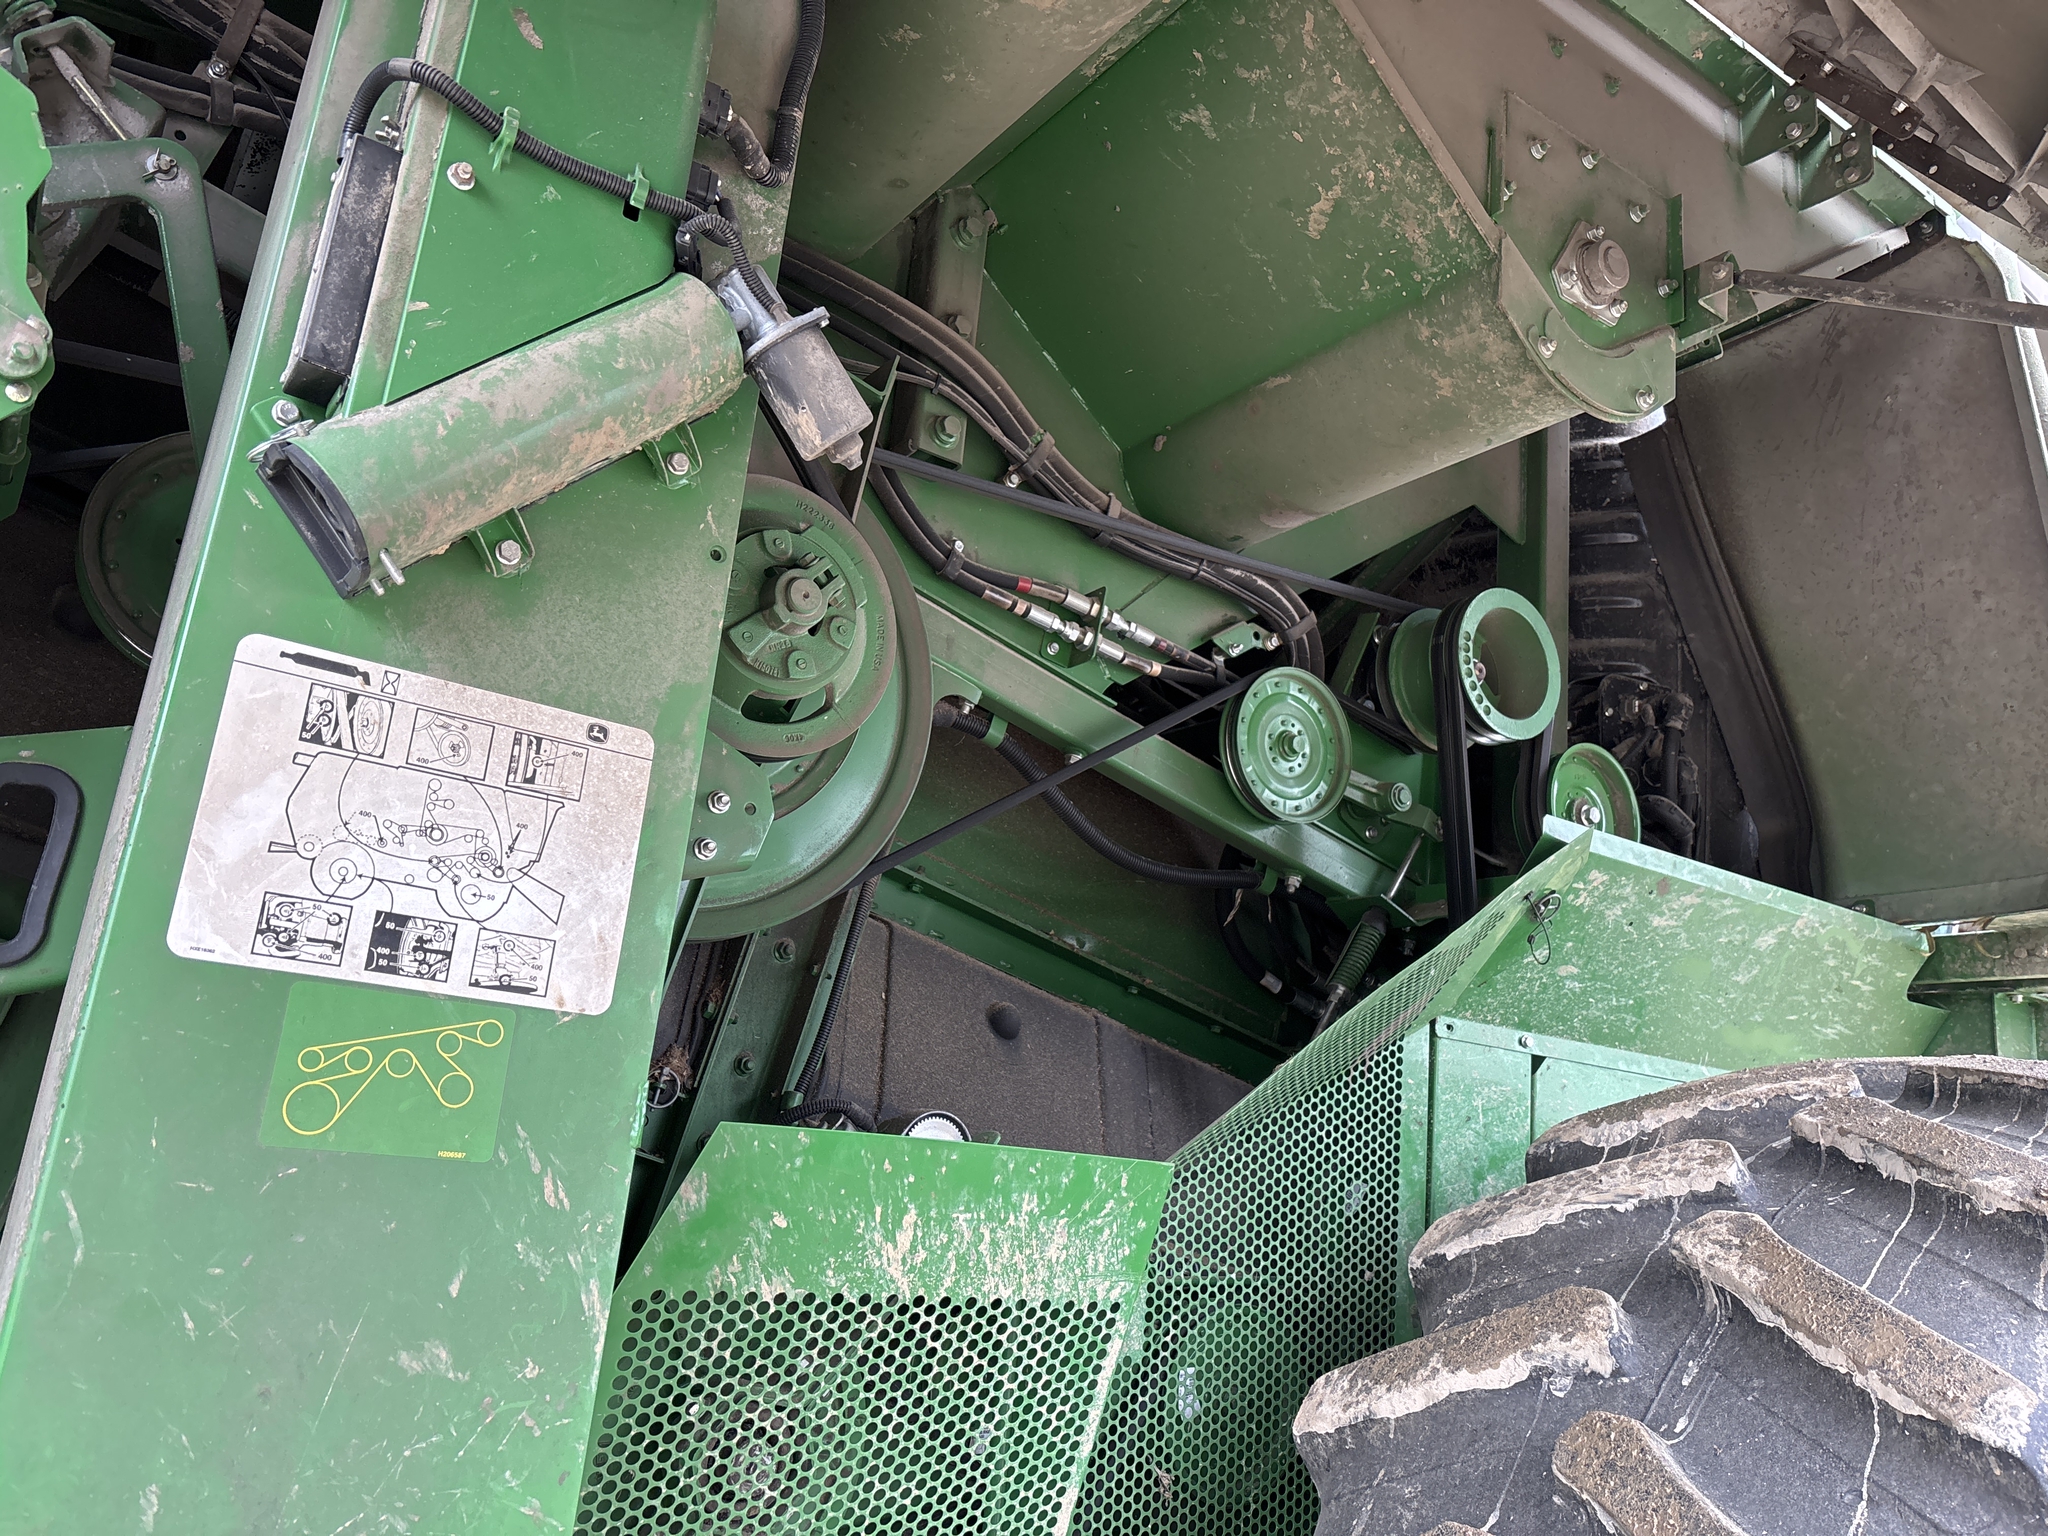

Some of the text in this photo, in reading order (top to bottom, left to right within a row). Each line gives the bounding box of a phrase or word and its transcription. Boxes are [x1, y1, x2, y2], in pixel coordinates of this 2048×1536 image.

[876, 614, 885, 640] MADE
[571, 750, 583, 758] 400
[358, 810, 372, 818] 400
[312, 903, 322, 911] 50
[385, 921, 395, 929] 50
[376, 946, 390, 955] 400
[318, 953, 332, 961] 400
[378, 958, 388, 966] 50
[531, 963, 543, 971] 400
